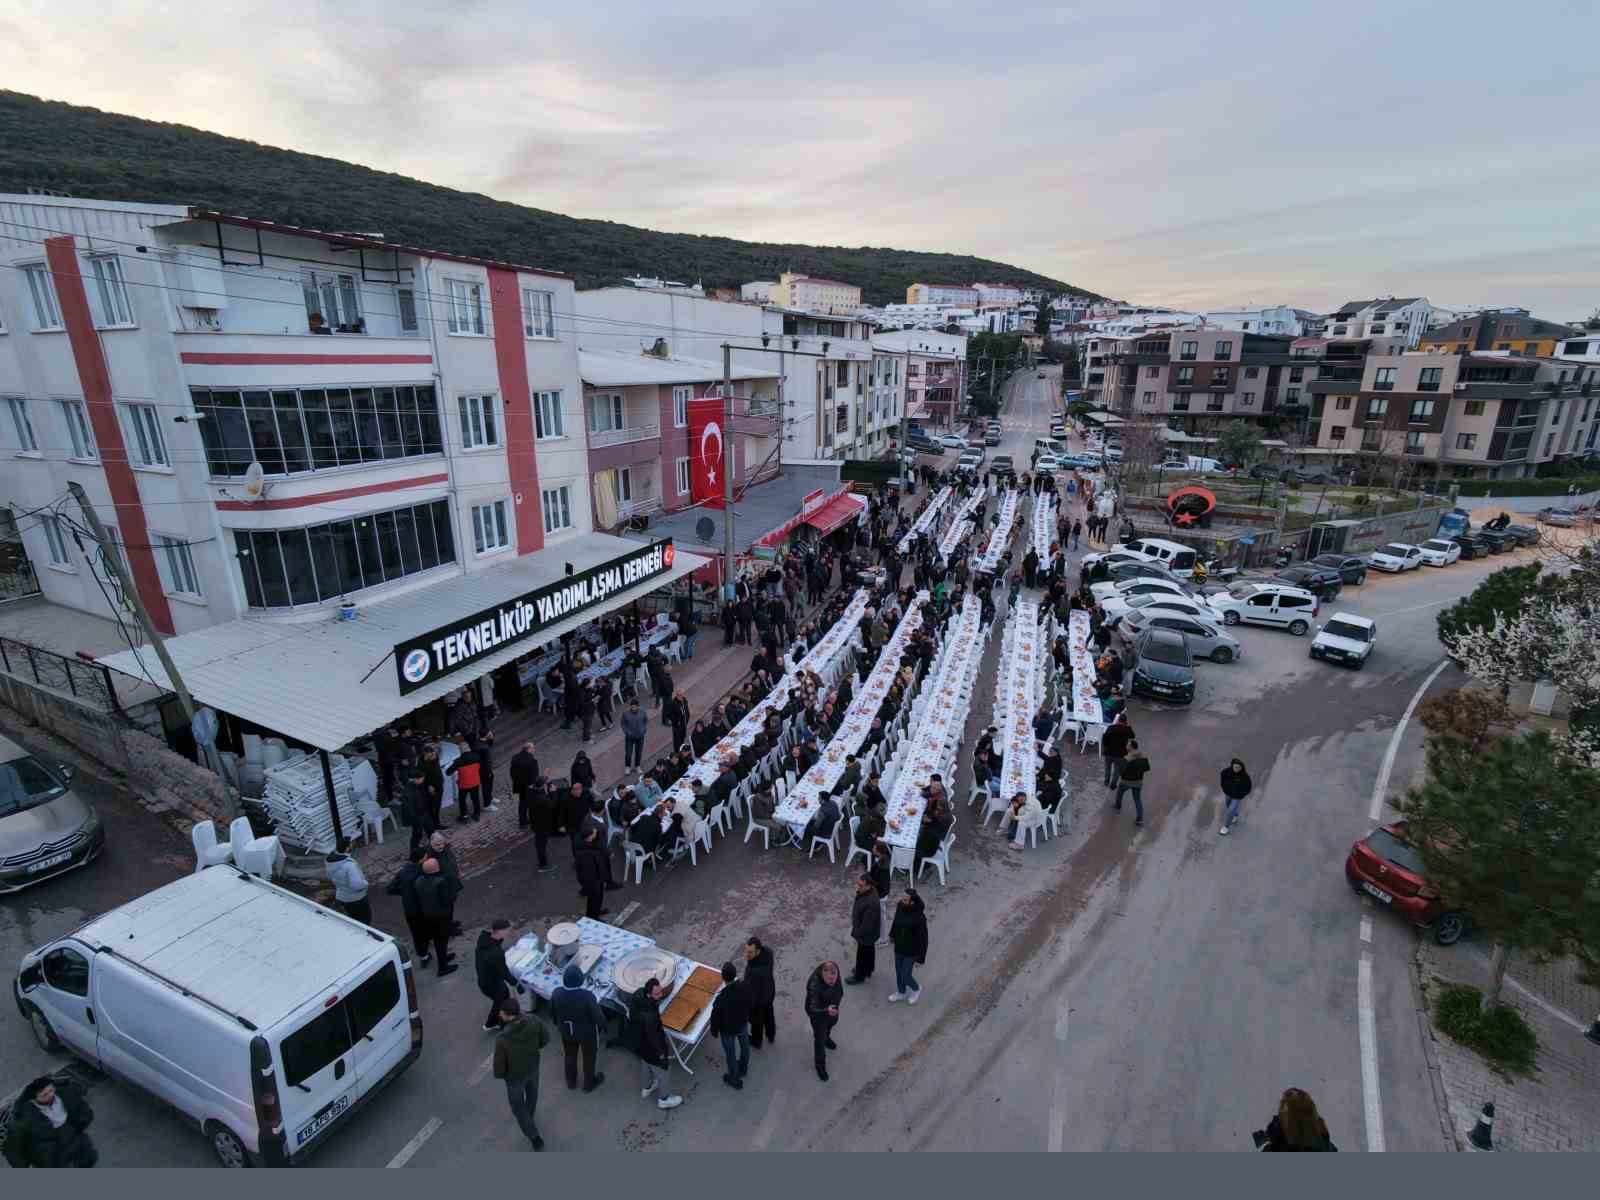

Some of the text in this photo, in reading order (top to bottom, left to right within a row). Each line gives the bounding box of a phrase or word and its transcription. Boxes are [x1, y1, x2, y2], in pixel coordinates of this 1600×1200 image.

[432, 545, 663, 671] TEKNELİKÜP YARDIMLAŞMA DERNEĞİ
